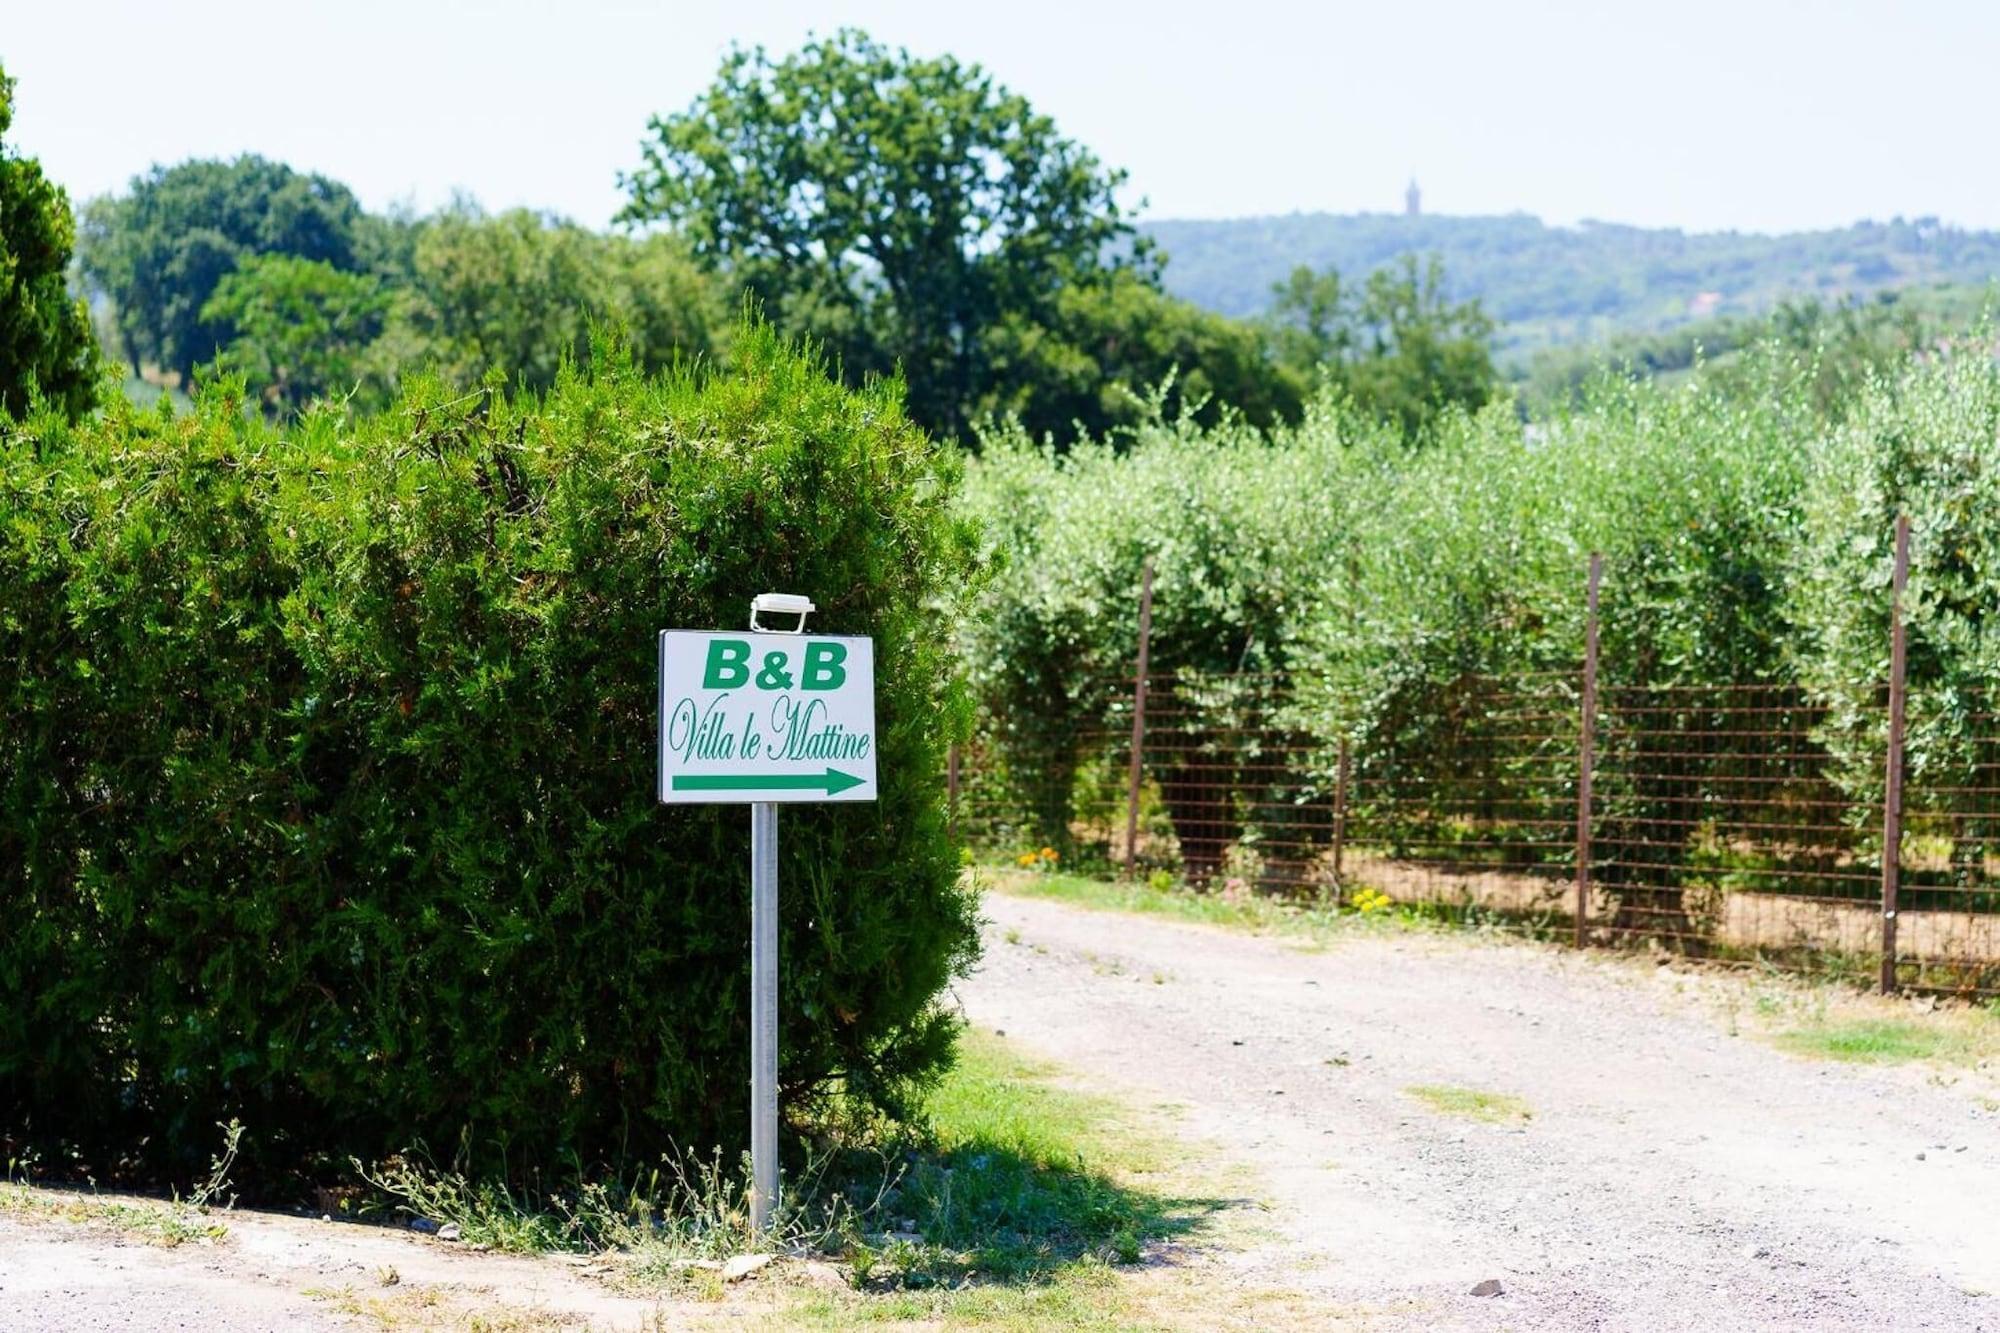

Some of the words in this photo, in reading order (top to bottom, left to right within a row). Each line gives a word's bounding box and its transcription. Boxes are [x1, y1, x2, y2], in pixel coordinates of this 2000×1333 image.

[702, 639, 848, 691] B&B
[669, 693, 736, 765] Villa
[740, 712, 761, 761] le
[767, 695, 870, 761] Mattine
